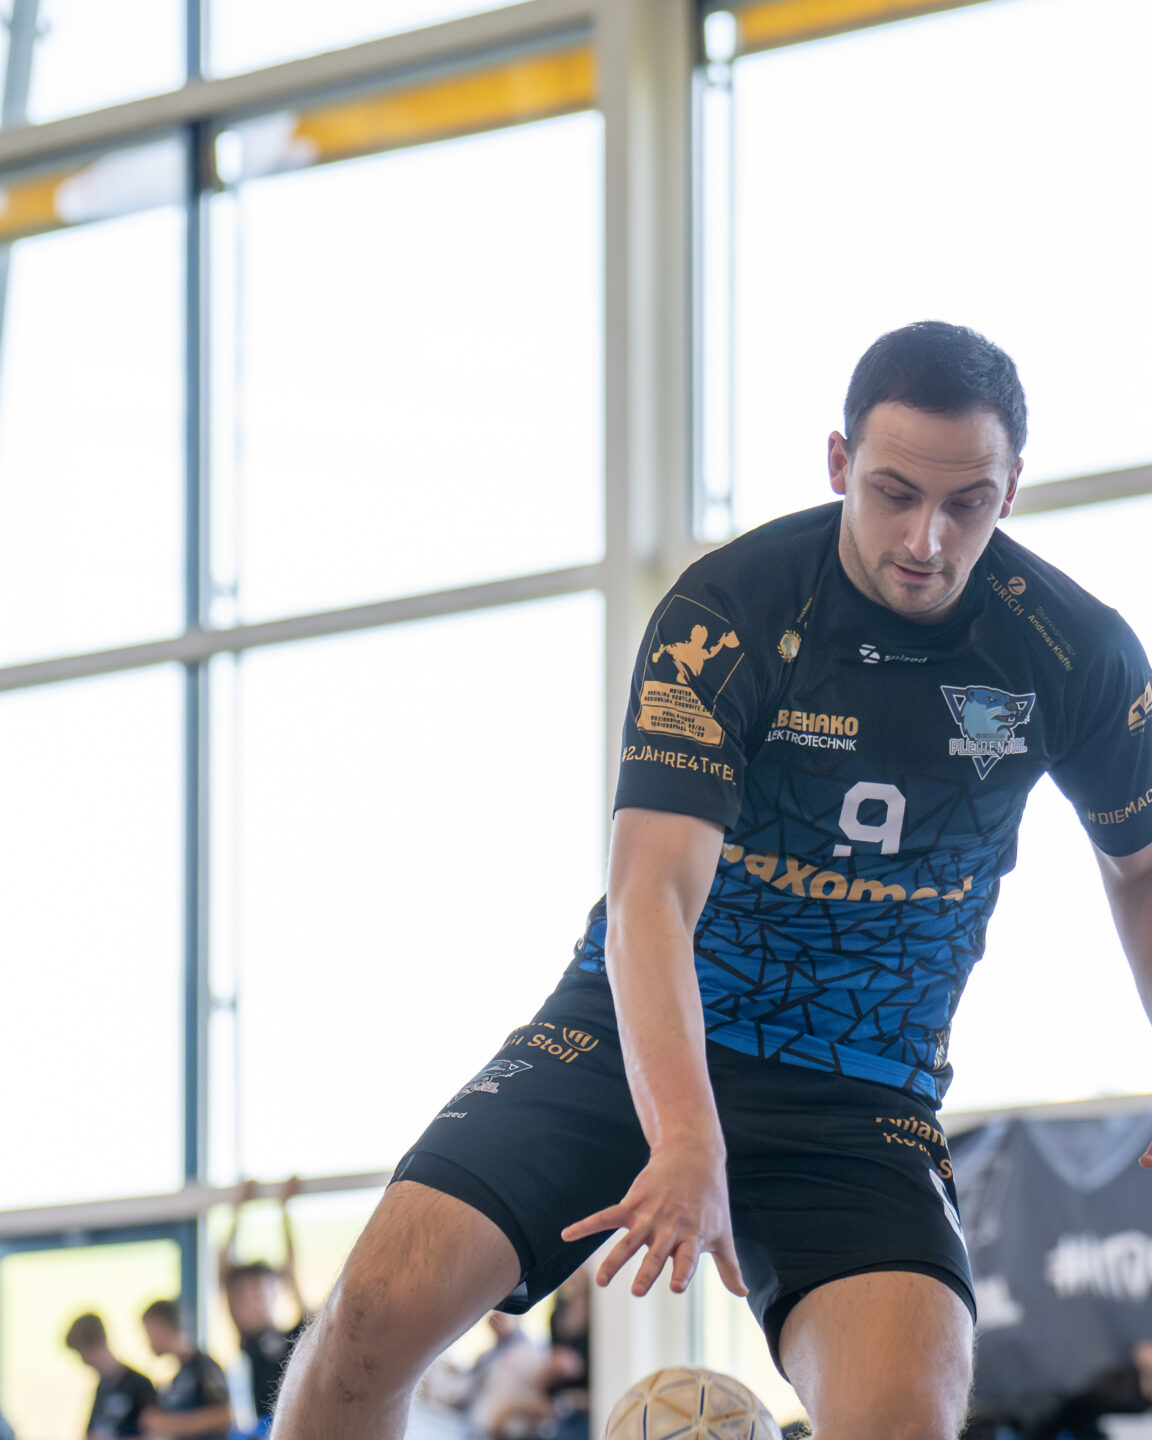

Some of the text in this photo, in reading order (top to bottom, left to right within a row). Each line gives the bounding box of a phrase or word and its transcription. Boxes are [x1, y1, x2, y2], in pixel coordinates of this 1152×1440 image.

[986, 572, 1024, 616] ZURICH
[765, 729, 858, 752] LEKTROTECHNIK
[833, 781, 906, 857] 9
[527, 1034, 579, 1063] Stoll
